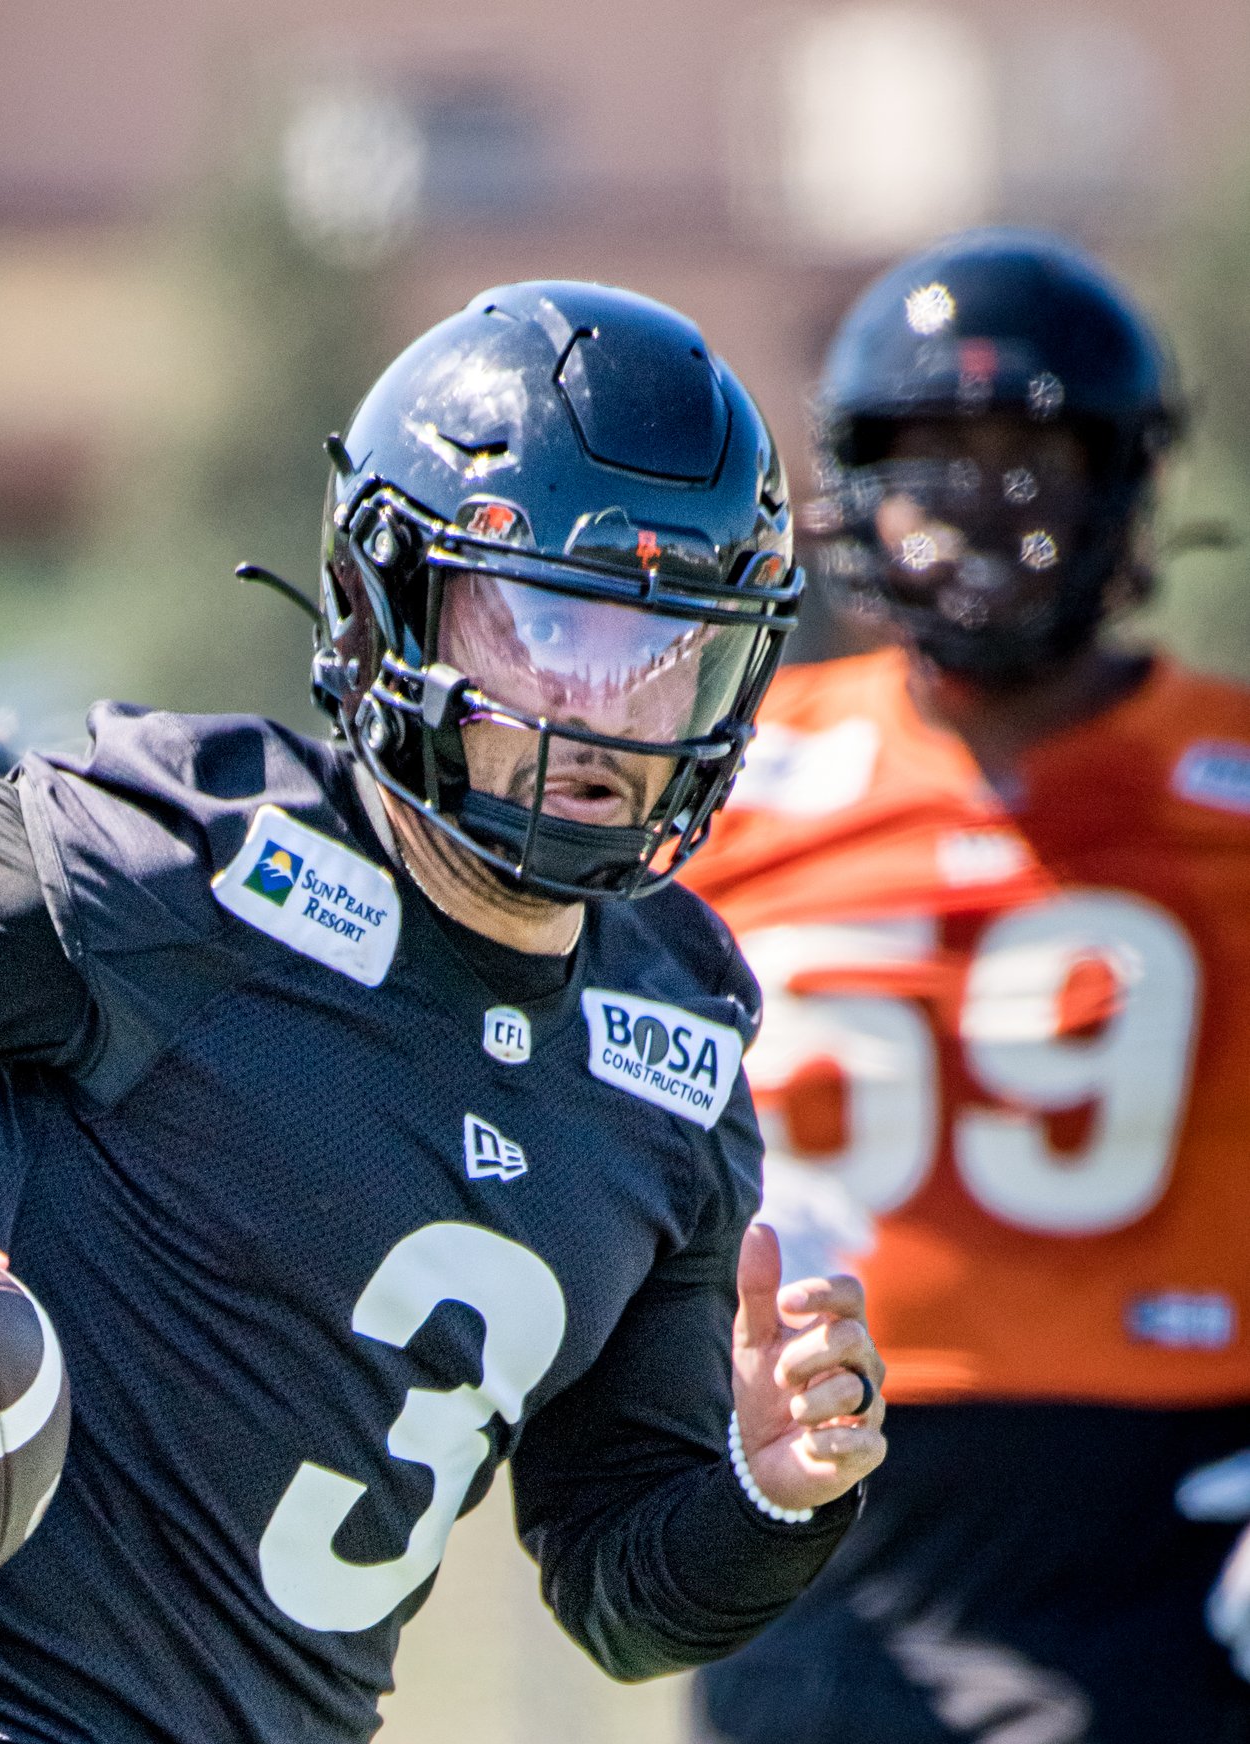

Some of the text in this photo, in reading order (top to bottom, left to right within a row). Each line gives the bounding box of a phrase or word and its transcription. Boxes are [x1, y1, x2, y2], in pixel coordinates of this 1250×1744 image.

[301, 896, 367, 943] RESORT
[494, 1020, 525, 1051] CFL
[602, 1003, 719, 1090] BOSA
[602, 1047, 715, 1112] CONSTRUCTION
[258, 1220, 567, 1633] 3
